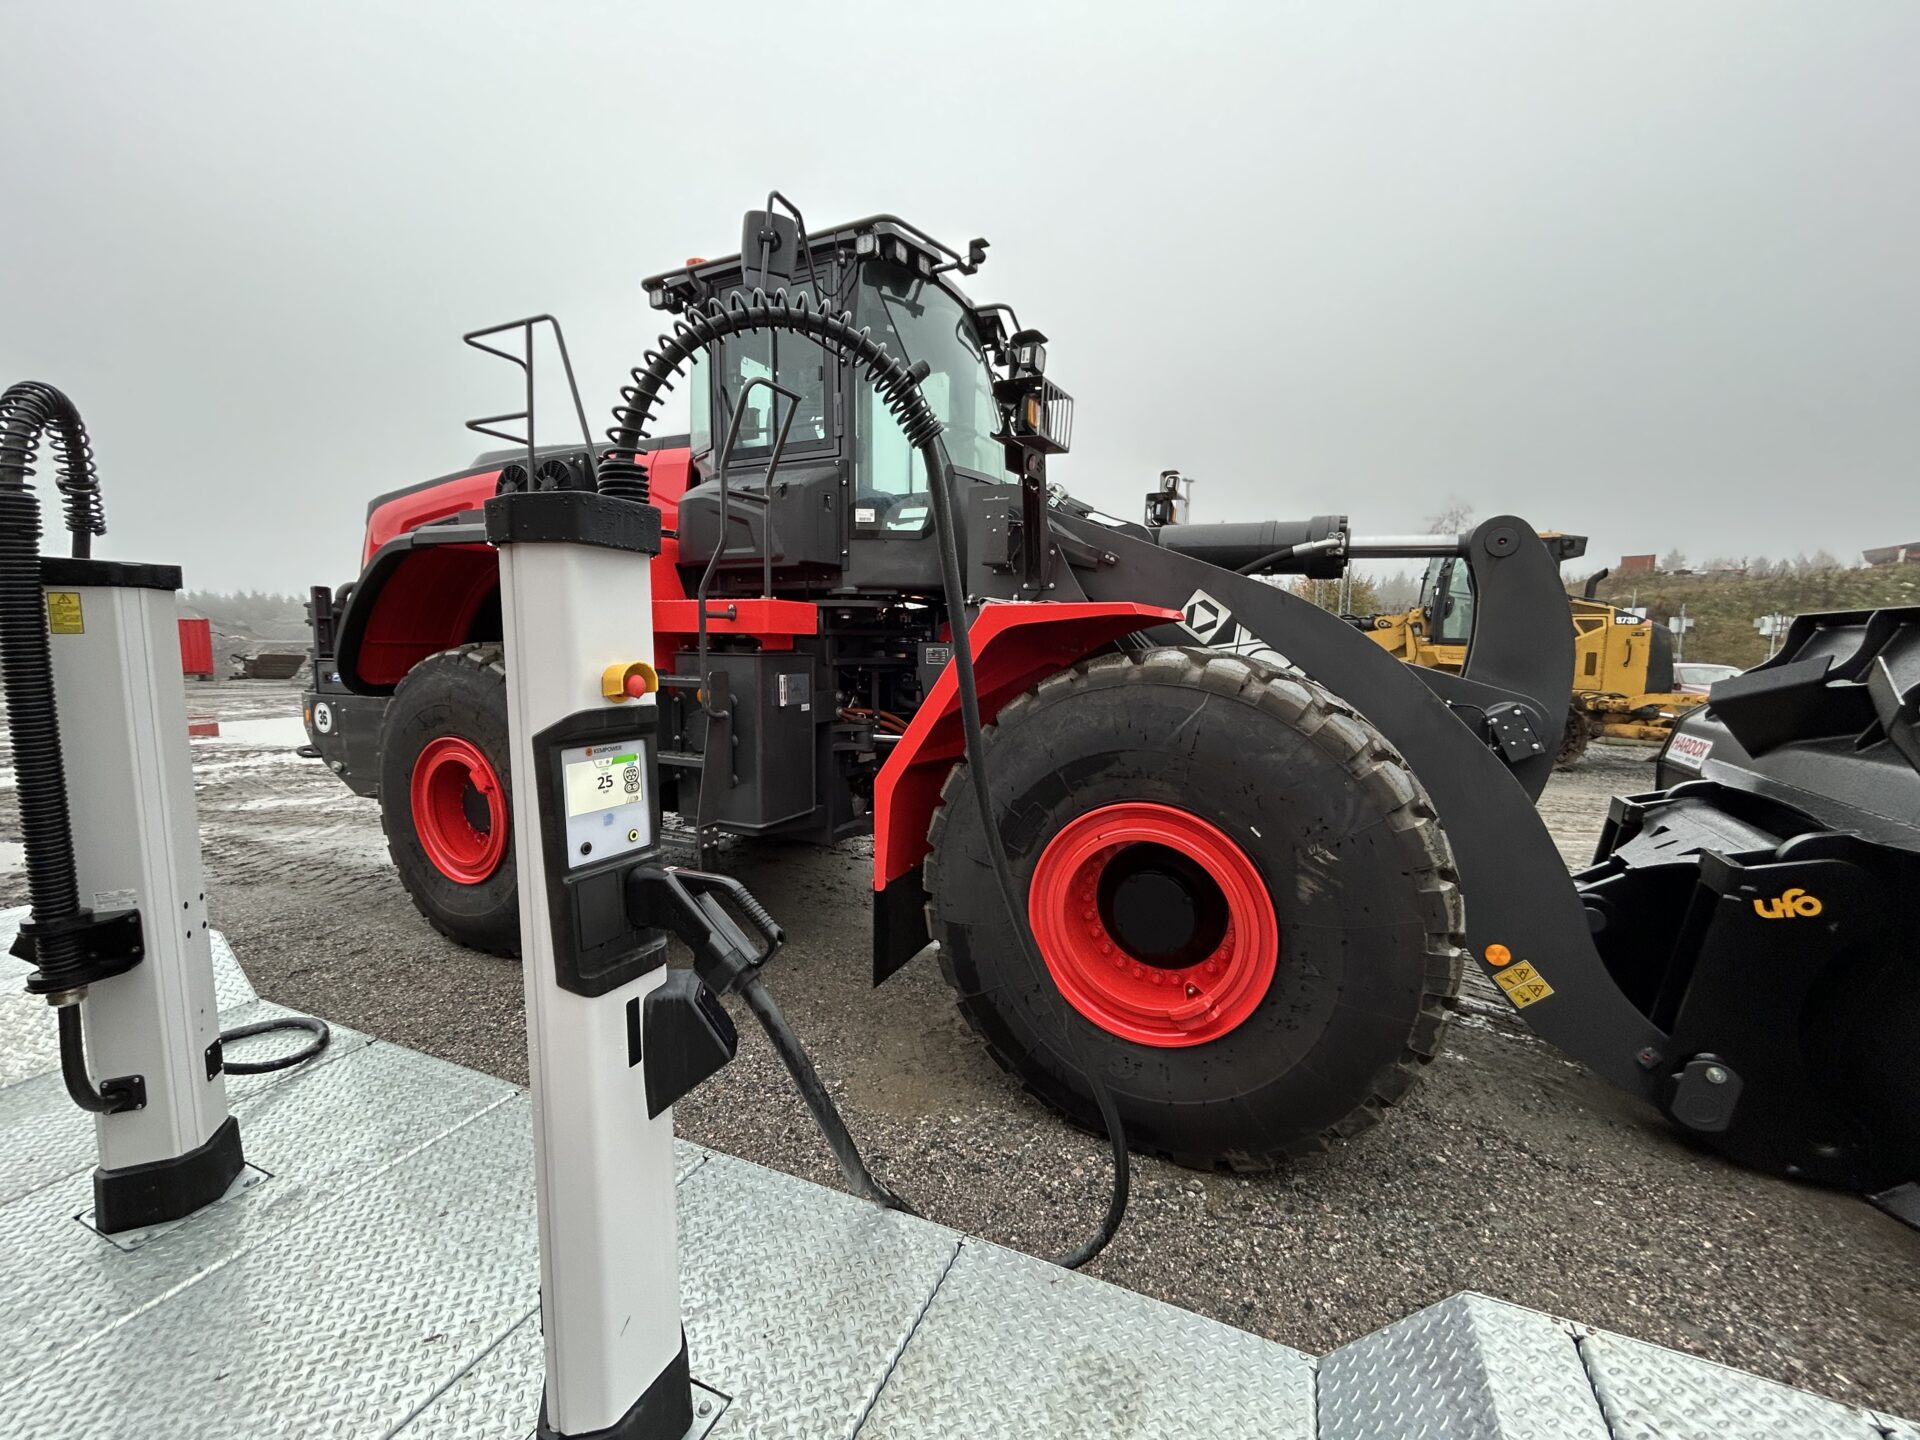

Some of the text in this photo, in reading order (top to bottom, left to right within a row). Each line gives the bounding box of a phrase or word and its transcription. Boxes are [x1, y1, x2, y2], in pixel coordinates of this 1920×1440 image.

[318, 709, 328, 726] 36
[593, 745, 622, 754] KEMPOWER
[1671, 735, 1711, 758] HARDOX
[597, 774, 613, 790] 25
